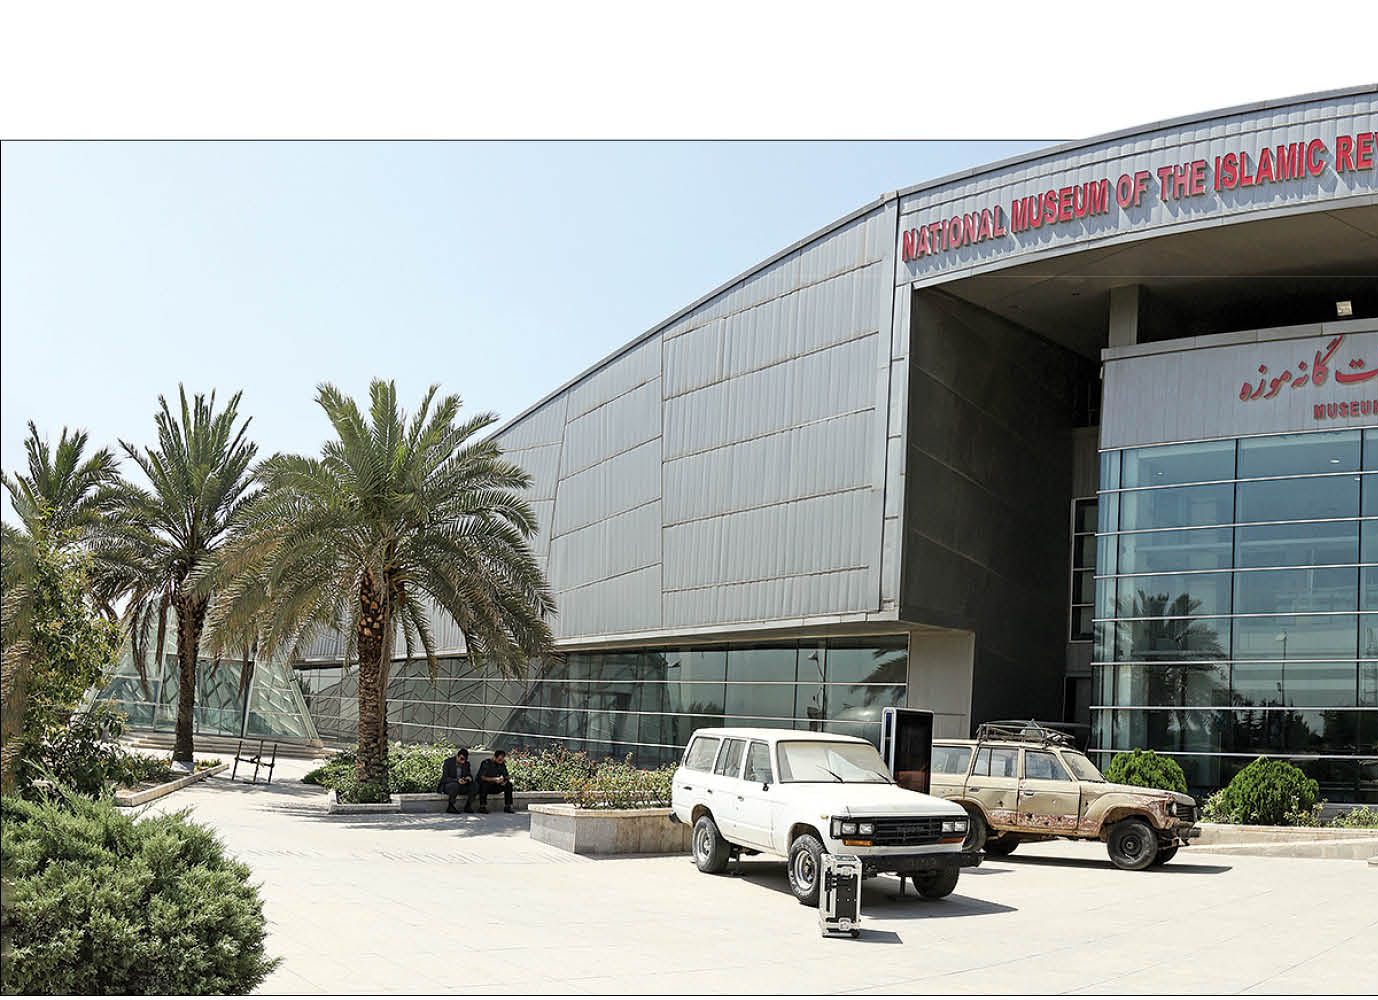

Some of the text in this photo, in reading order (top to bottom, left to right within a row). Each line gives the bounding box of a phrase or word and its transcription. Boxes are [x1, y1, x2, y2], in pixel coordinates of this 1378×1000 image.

[902, 205, 1006, 262] NATIONAL
[1011, 178, 1109, 233] MUSEUM
[1116, 170, 1149, 208] OF
[1157, 162, 1206, 201] THE
[1213, 138, 1325, 192] ISLAMIC
[1239, 364, 1292, 401] موزه
